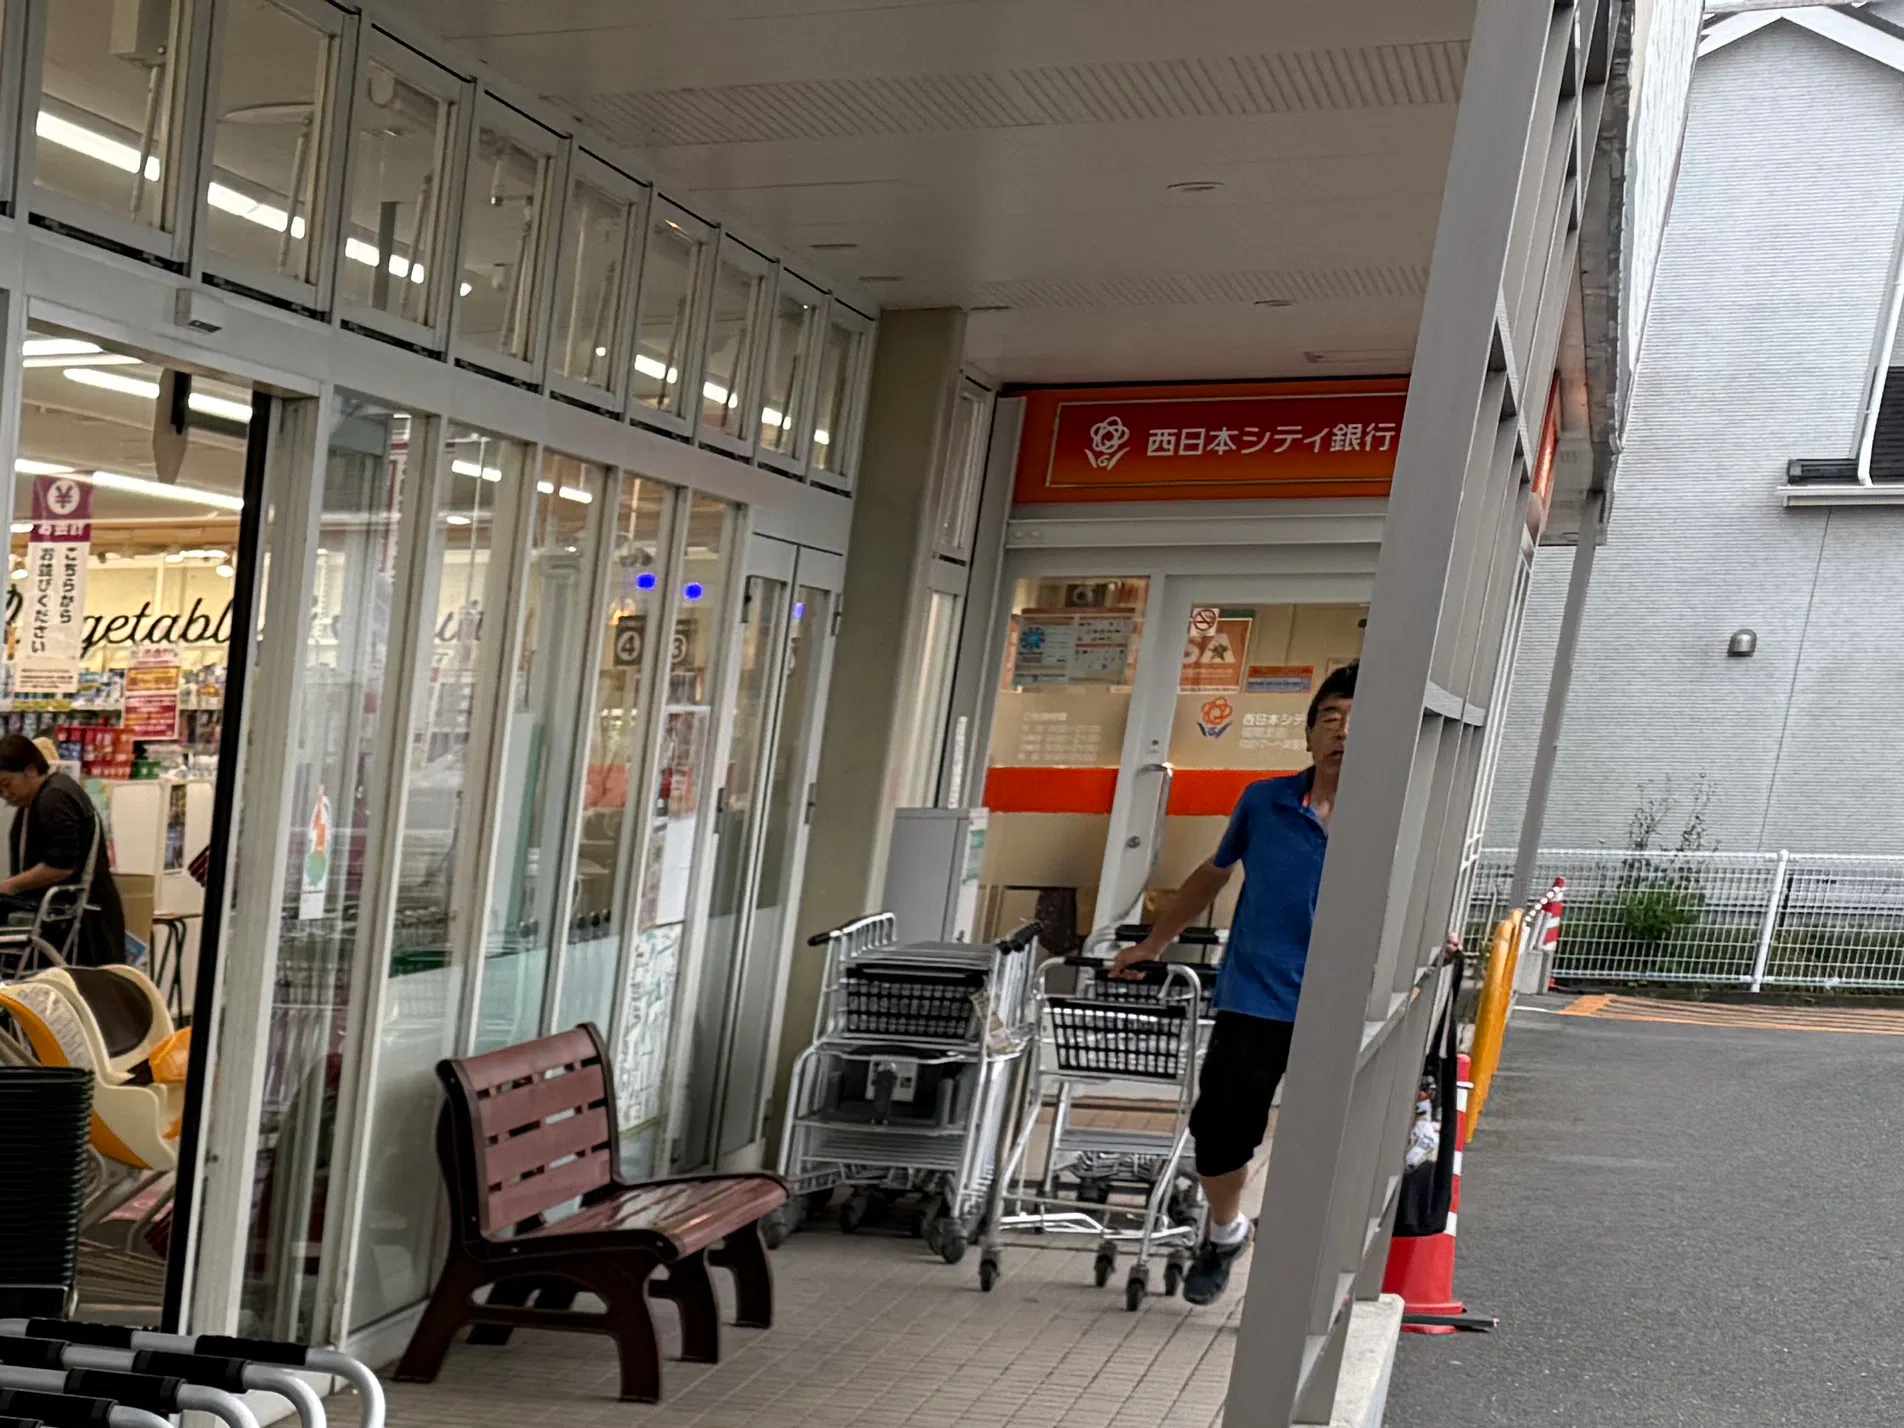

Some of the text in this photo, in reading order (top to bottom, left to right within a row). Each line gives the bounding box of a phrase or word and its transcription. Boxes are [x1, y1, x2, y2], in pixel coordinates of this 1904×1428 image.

[1147, 423, 1396, 456] 西日本シティ銀行
[30, 547, 56, 654] お並びください
[59, 546, 79, 625] こちらから
[1242, 712, 1305, 726] 西日本シテ
